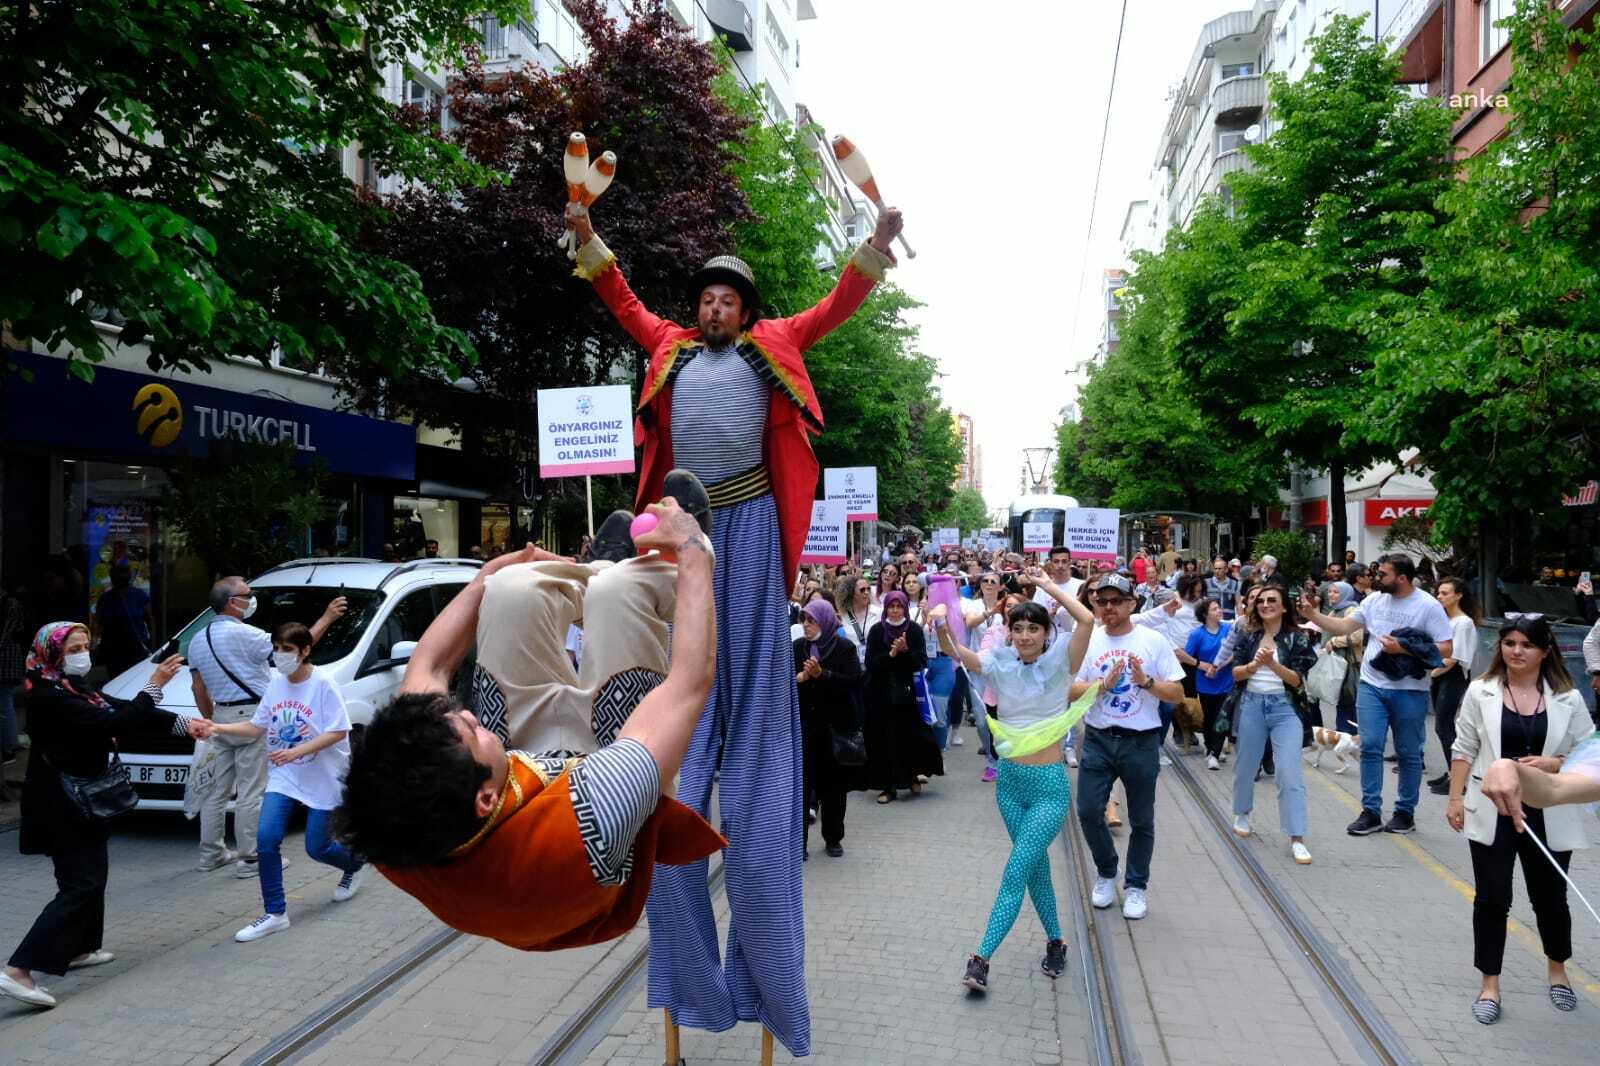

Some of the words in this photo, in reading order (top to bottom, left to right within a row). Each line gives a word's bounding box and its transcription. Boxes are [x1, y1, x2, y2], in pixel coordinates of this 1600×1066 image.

[192, 404, 317, 452] TURKCELL
[548, 420, 623, 433] ÖNYARGINIZ
[554, 432, 619, 447] ENGELİNİZ
[557, 448, 617, 460] OLMASIN!
[140, 767, 154, 781] BF
[164, 768, 187, 782] 837
